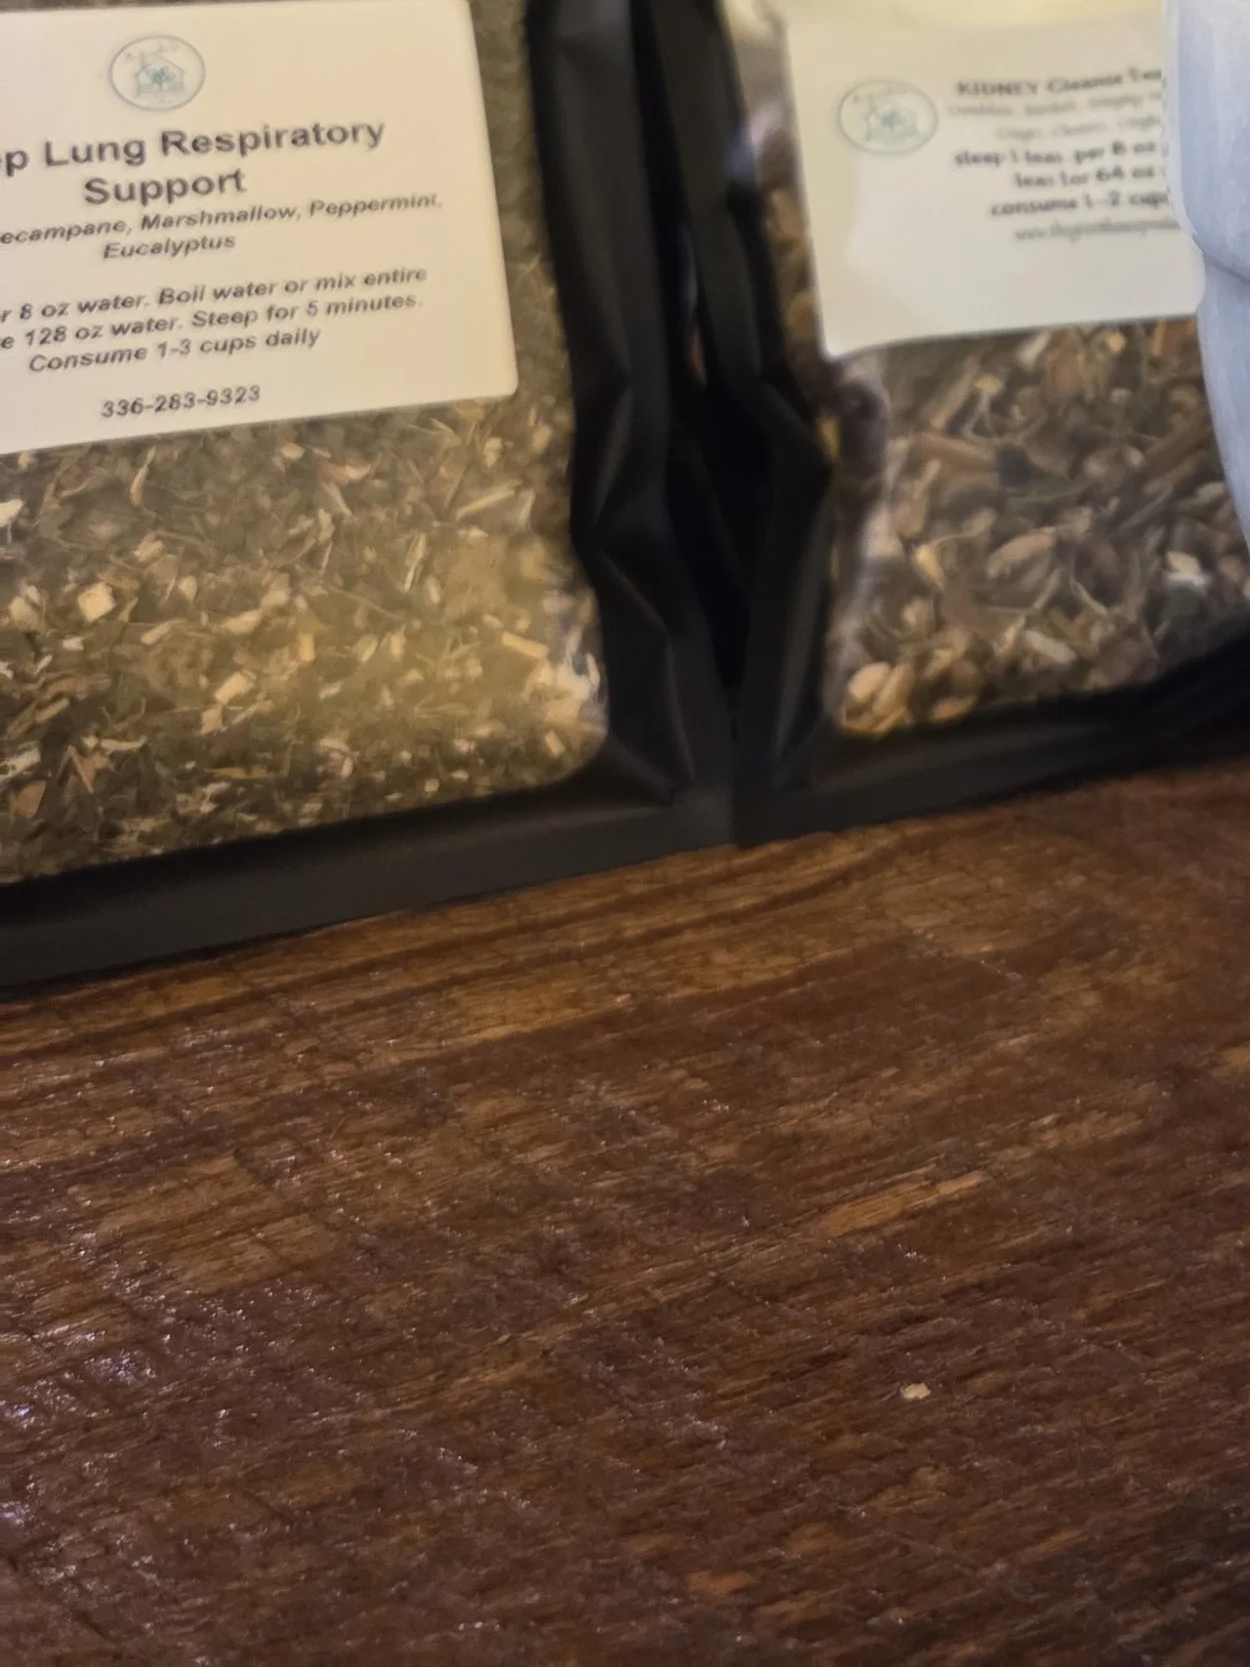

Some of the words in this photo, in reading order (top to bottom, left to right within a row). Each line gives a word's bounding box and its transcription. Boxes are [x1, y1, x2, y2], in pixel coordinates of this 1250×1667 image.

[956, 81, 1037, 96] KIDNEY
[45, 138, 147, 167] Lung
[161, 121, 385, 157] Respiratory
[85, 168, 246, 206] Support
[140, 203, 301, 231] Marshmallow,
[309, 192, 442, 218] Peppermint,
[103, 233, 237, 260] Eucalyptus
[20, 302, 34, 321] 8
[41, 302, 71, 318] oz
[78, 292, 150, 314] water.
[158, 284, 206, 305] Boil
[213, 281, 277, 300] water
[284, 278, 309, 294] or
[315, 272, 357, 291] mix
[364, 266, 428, 285] entire
[25, 324, 67, 347] 128
[75, 325, 104, 340] oz
[110, 316, 182, 337] water.
[192, 309, 258, 328] Steep
[266, 303, 299, 322] for
[306, 299, 319, 317] 5
[326, 292, 423, 316] minutes.
[29, 346, 149, 373] Consume
[157, 337, 192, 358] 1-3
[200, 335, 257, 356] cups
[265, 327, 321, 348] daily
[101, 384, 261, 419] 336-283-9323
